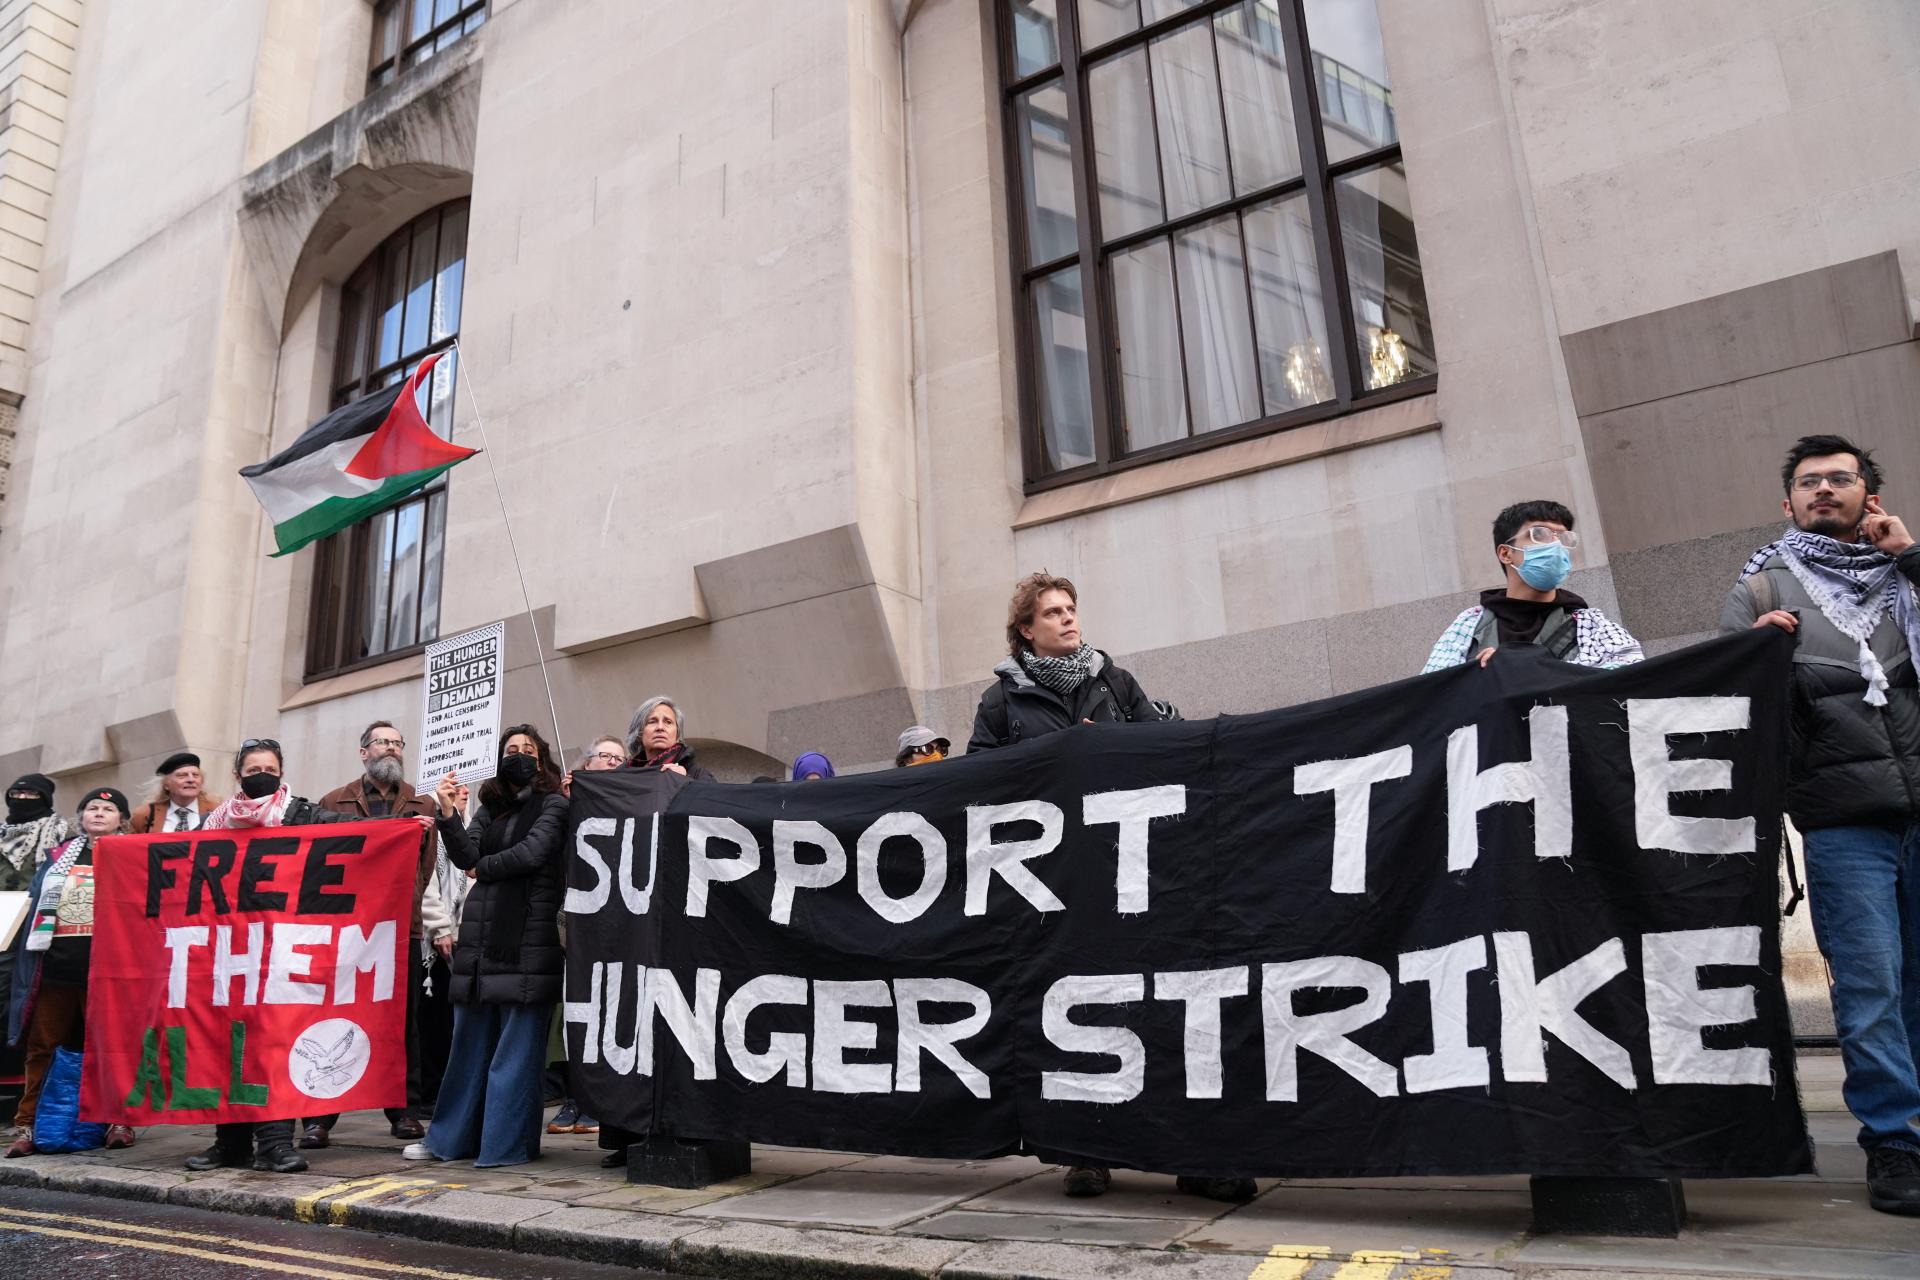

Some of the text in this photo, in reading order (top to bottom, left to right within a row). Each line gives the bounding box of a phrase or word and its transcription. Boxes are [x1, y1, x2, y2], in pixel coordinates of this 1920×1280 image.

[431, 638, 496, 670] THE HUNGER
[430, 657, 496, 692] STRIKERS
[441, 681, 494, 709] DEMAND:
[430, 718, 474, 737] IMMEDIATE BAIL
[431, 700, 490, 724] END ALL CENSORSHIP
[428, 739, 446, 751] RIGHT
[447, 737, 455, 746] TO
[461, 731, 475, 742] FAIR
[476, 727, 493, 738] TRIAL
[426, 758, 479, 778] SHUT ELBIT DOWN!
[427, 748, 465, 765] DEPROSCRIBE
[564, 697, 1757, 924] SUPPORT THE
[145, 835, 367, 918] FREE
[164, 920, 397, 1008] THEM
[563, 926, 1772, 1104] HUNGER STRIKE
[125, 1021, 269, 1112] ALL
